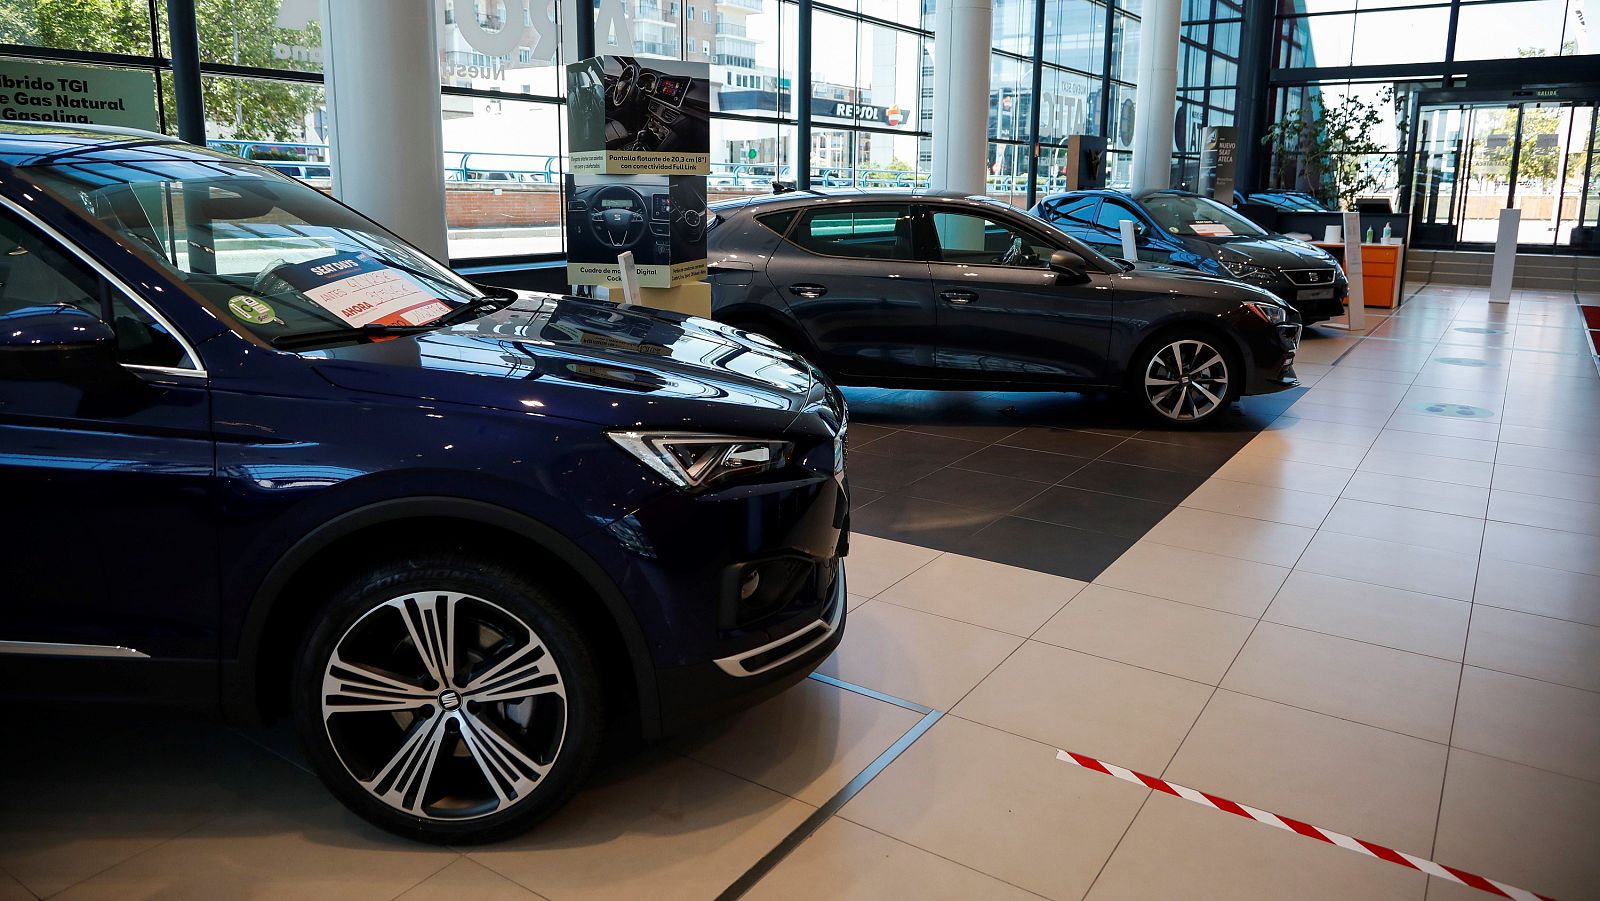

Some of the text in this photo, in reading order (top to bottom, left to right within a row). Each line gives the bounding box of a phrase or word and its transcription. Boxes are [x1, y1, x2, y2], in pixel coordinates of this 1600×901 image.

[57, 79, 89, 93] TGI
[14, 92, 52, 107] Gas
[56, 94, 125, 111] Natural
[2, 107, 94, 124] Gasolina.
[310, 262, 336, 275] SEAT
[336, 259, 359, 270] DAYS
[636, 268, 657, 276] Digital
[320, 288, 348, 303] ANTES
[341, 301, 374, 318] AHORA
